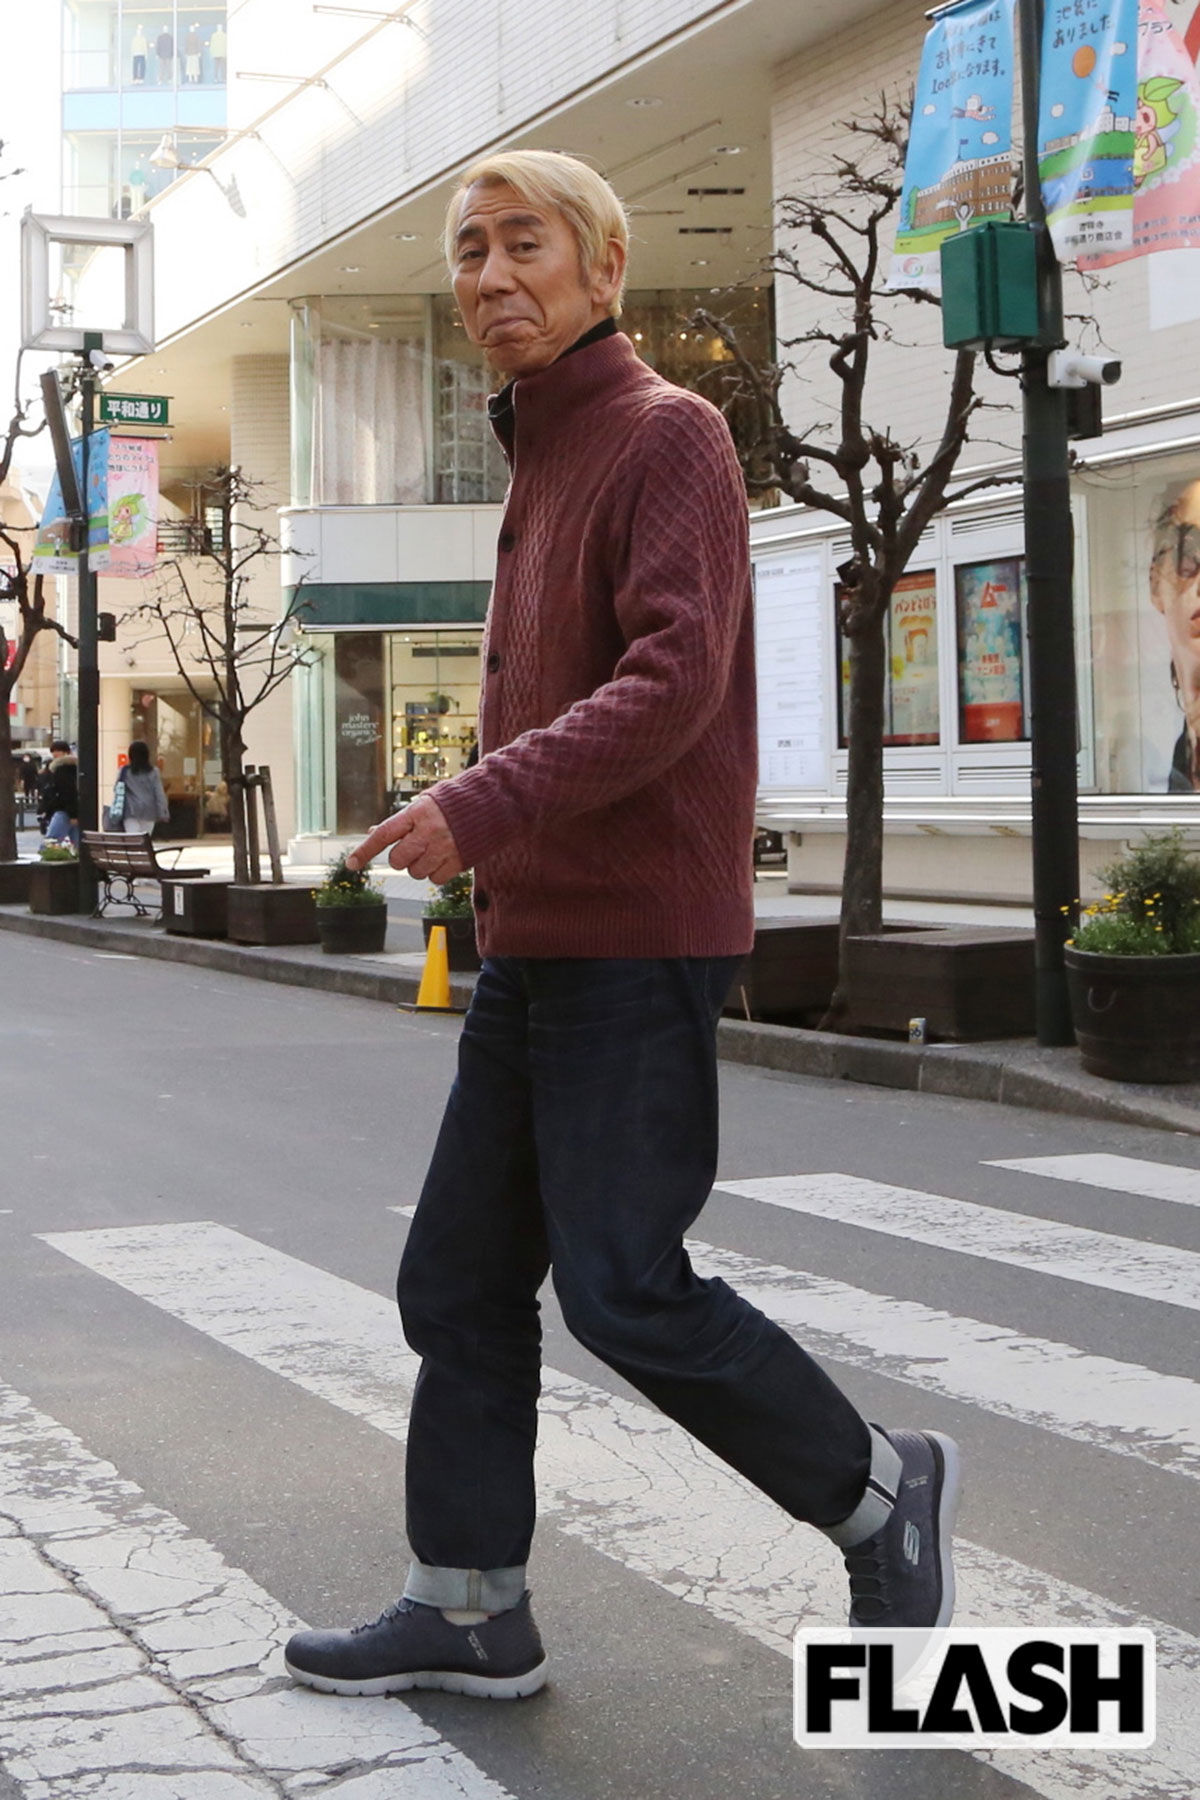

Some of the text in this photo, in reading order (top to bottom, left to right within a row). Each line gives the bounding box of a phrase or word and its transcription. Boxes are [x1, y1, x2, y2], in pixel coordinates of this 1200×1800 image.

[1053, 14, 1111, 48] ありました
[107, 400, 161, 419] 平和通り
[349, 713, 370, 722] john
